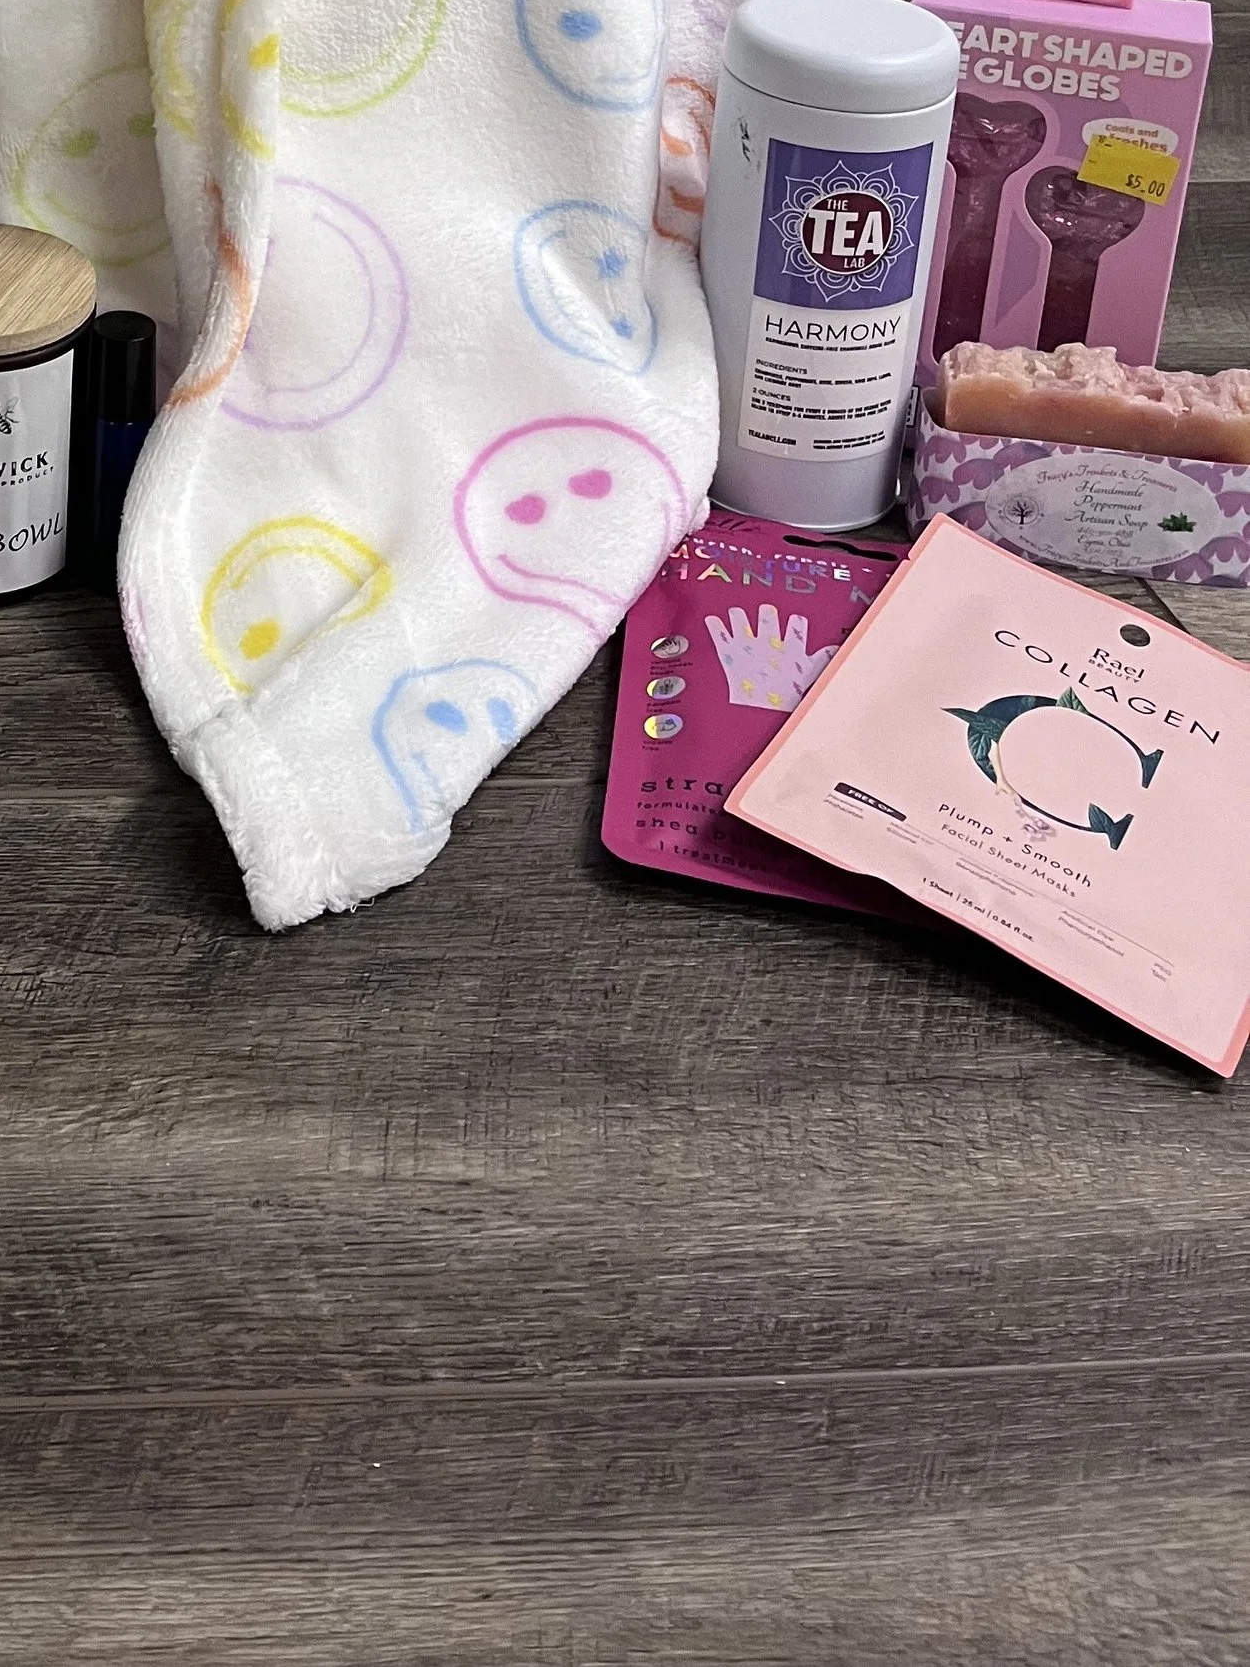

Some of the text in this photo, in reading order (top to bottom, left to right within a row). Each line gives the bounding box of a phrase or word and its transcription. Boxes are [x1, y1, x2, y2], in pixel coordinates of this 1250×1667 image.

[1043, 35, 1193, 79] SHAPED
[974, 58, 1121, 101] GLOBES
[1125, 173, 1166, 197] $5.00
[827, 198, 849, 210] THE
[808, 209, 884, 256] TEA
[844, 257, 866, 269] LAB
[765, 315, 901, 342] HARMONY
[755, 358, 808, 374] INGREDIENTS
[758, 389, 791, 402] OUNCES
[1, 465, 55, 487] PRODUCT
[1075, 479, 1147, 498] Handmade
[1074, 495, 1143, 513] Peppermint
[1118, 513, 1149, 531] Soap
[1088, 658, 1141, 684] BEAUTY
[1091, 647, 1146, 679] Rael
[994, 630, 1221, 745] COLLAGEN
[848, 789, 877, 805] FREE
[636, 817, 700, 836] shea
[939, 803, 994, 836] Plump
[1021, 844, 1092, 888] Smooth
[941, 823, 983, 849] Facial
[987, 846, 1028, 871] Sheet
[1031, 868, 1076, 898] Masks
[929, 880, 954, 898] Sheet
[961, 898, 974, 908] 25
[973, 905, 986, 915] ml
